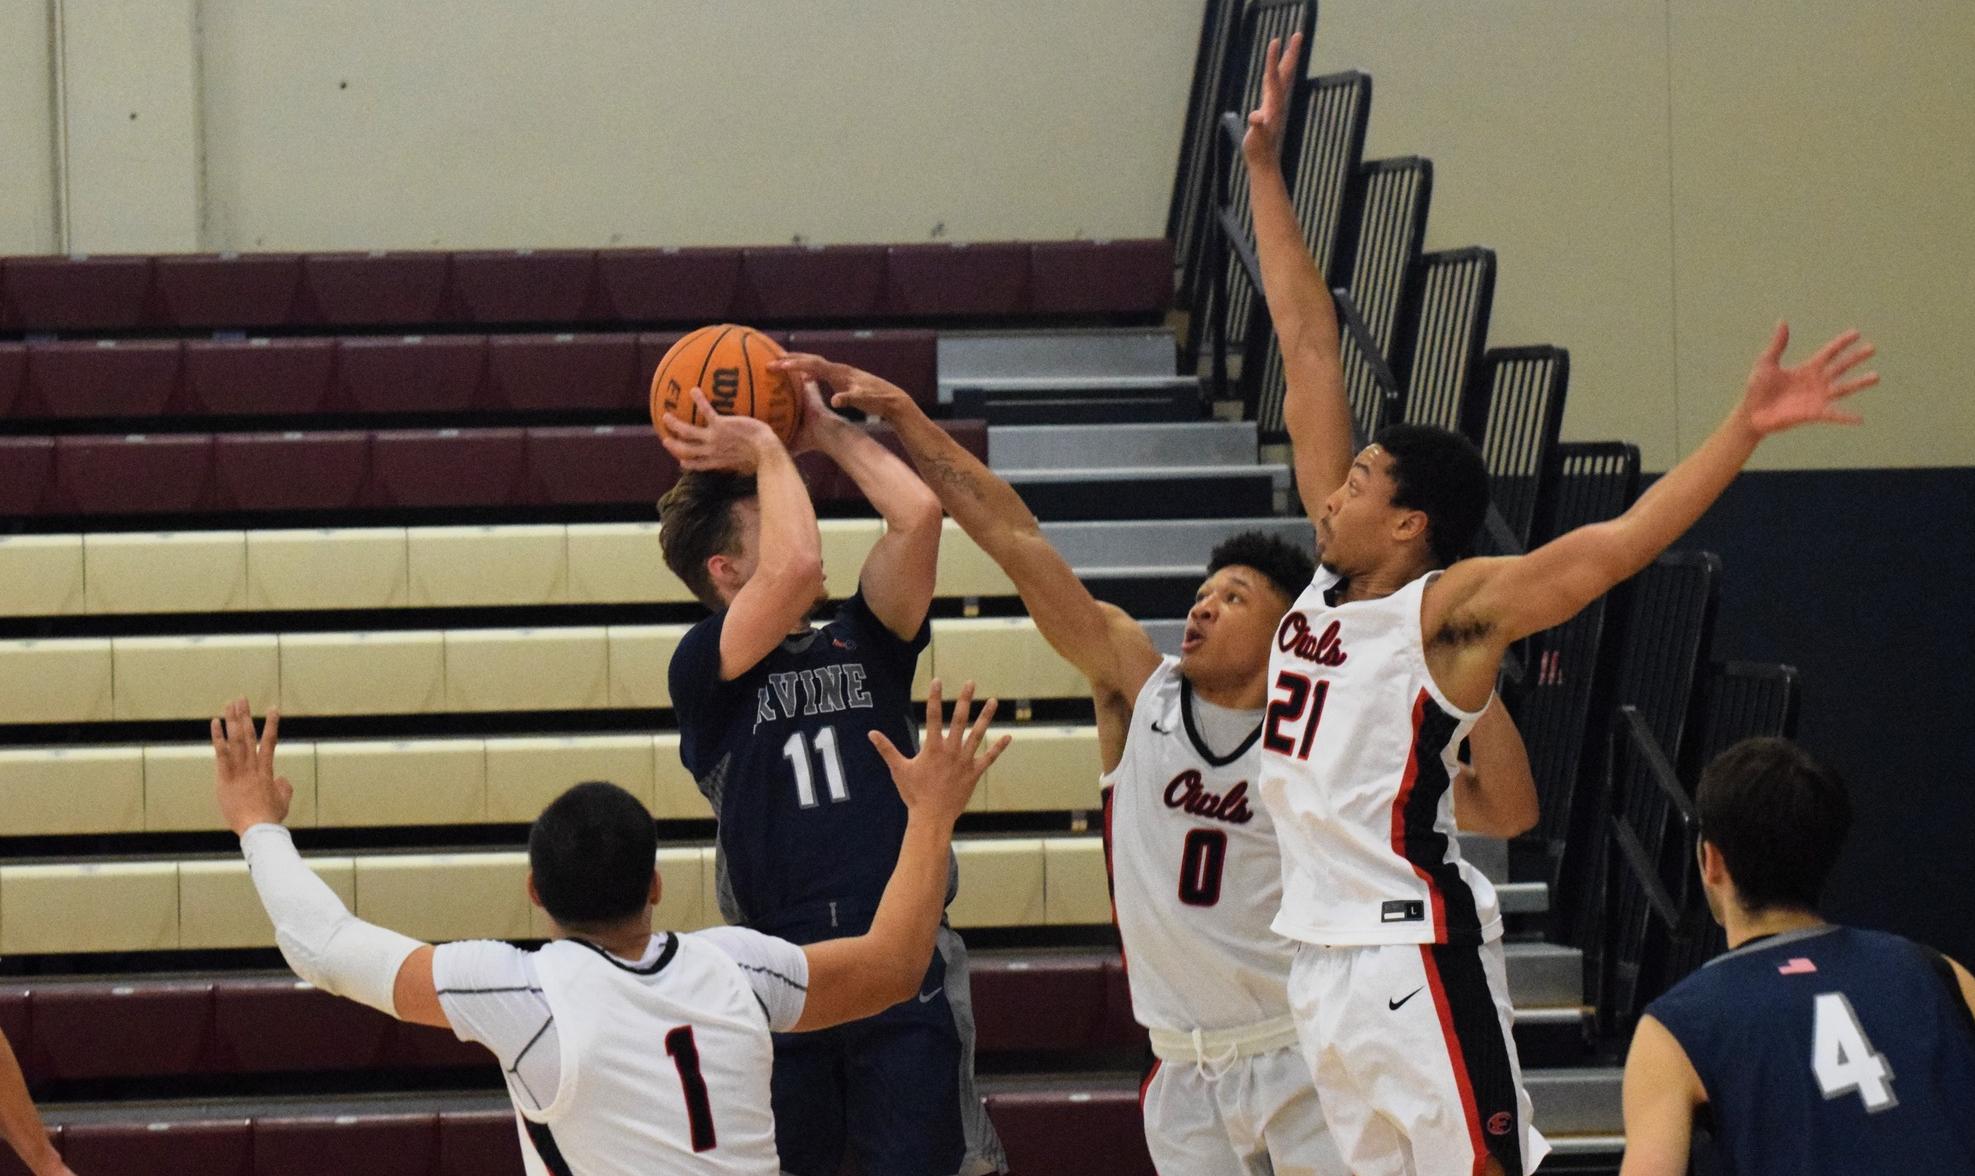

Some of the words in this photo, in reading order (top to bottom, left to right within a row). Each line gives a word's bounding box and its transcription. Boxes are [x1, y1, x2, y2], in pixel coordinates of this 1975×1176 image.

[1278, 611, 1348, 667] Owls
[1263, 670, 1330, 761] 21
[783, 725, 850, 809] 11
[1163, 769, 1254, 824] Owls
[1178, 828, 1228, 908] 0
[665, 1024, 717, 1153] 1
[1811, 991, 1899, 1114] 4
